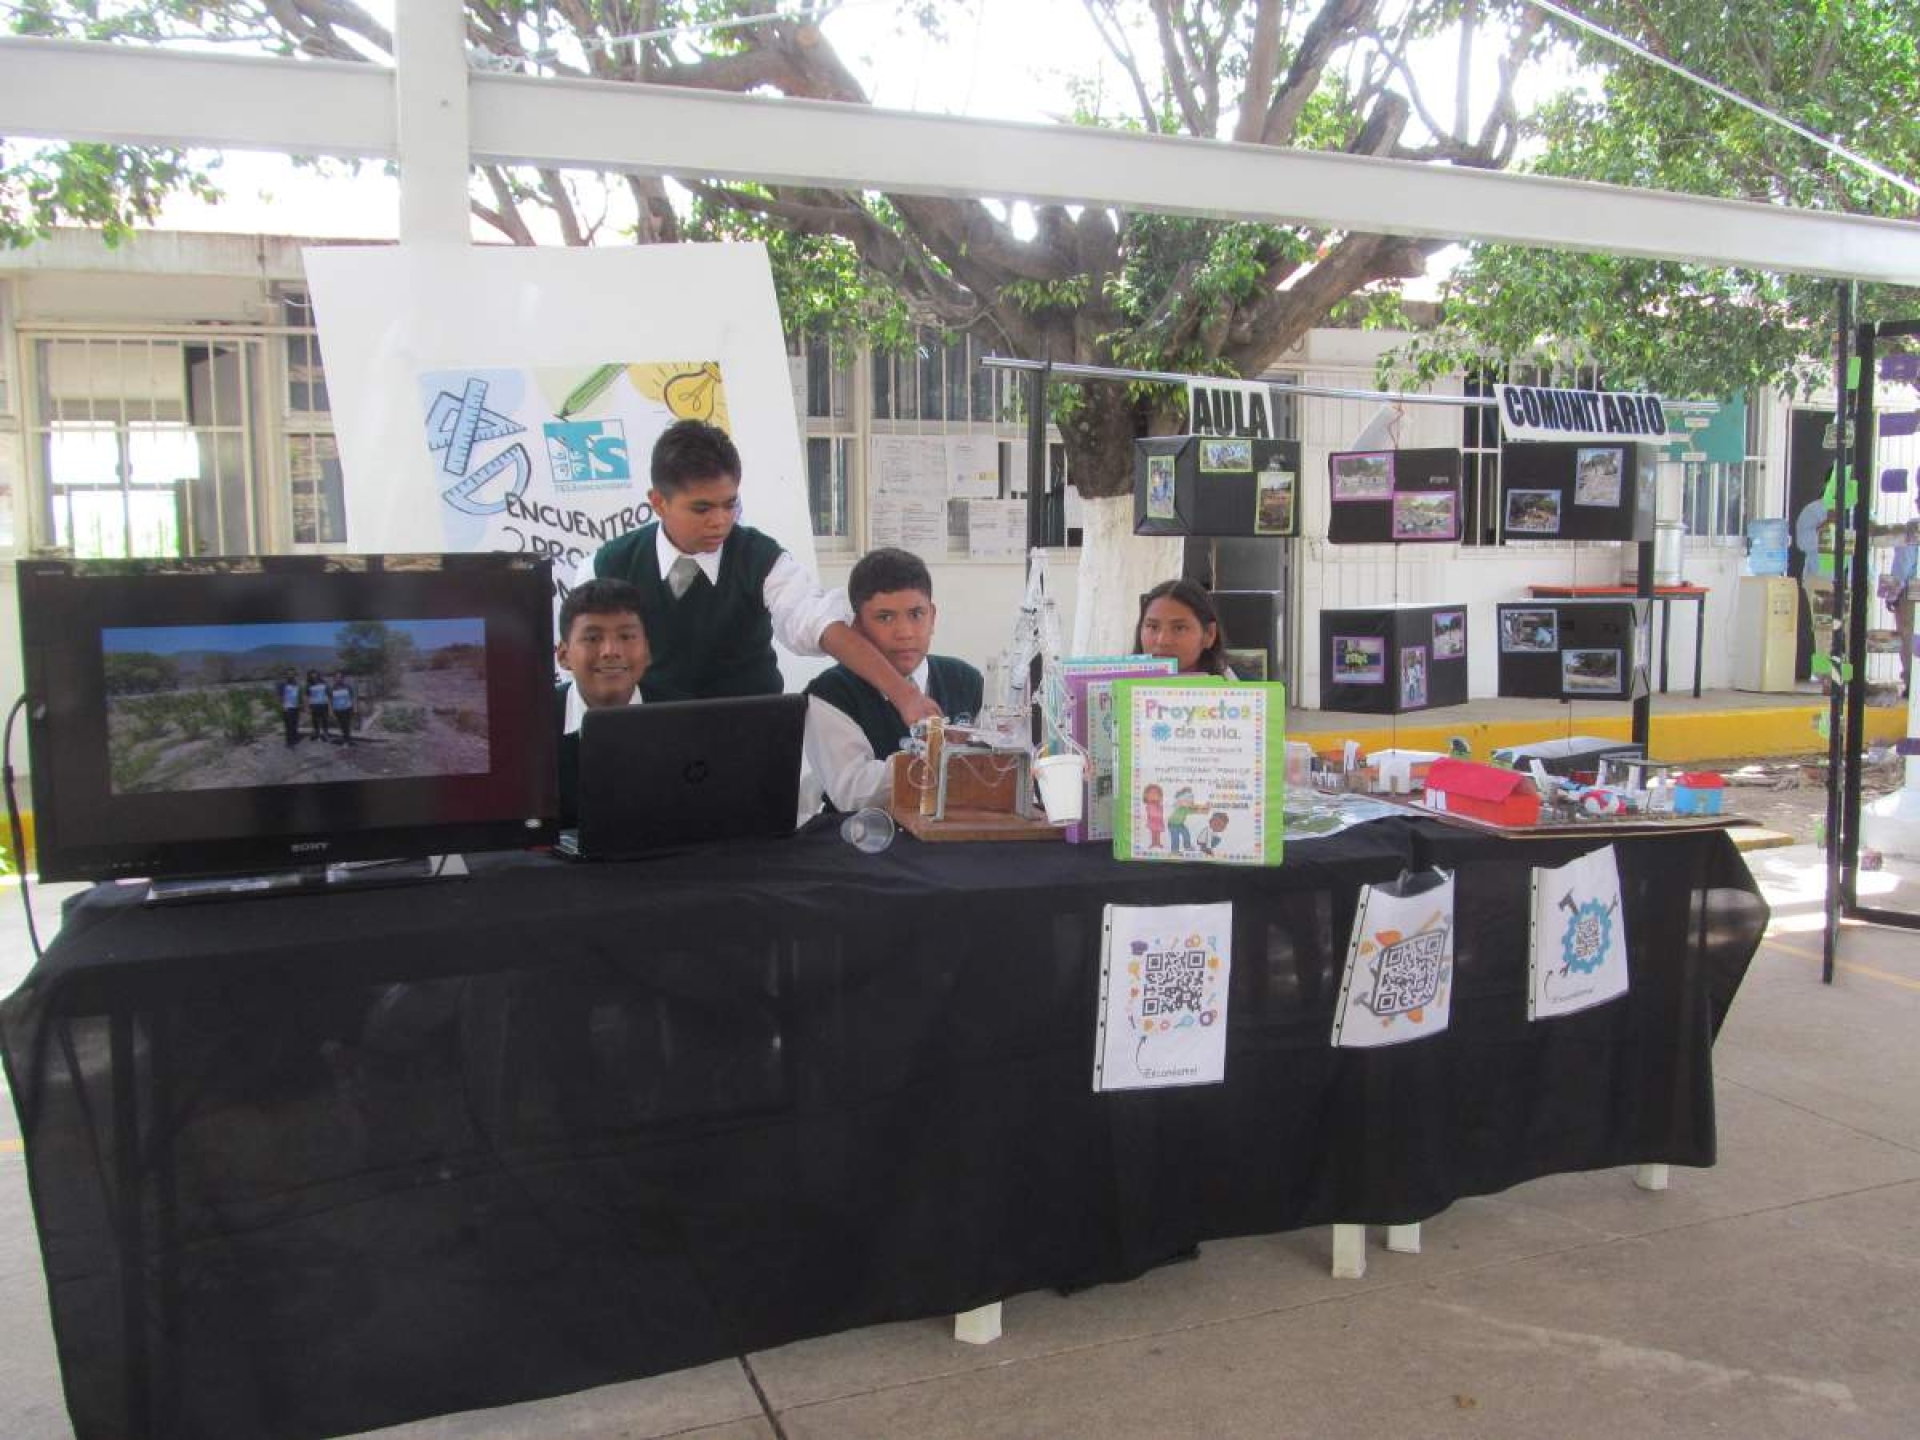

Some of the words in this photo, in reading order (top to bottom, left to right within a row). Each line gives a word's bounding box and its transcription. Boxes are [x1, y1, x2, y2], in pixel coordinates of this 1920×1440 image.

[1191, 387, 1270, 437] AULA
[1503, 386, 1666, 436] COMUNITARIO
[505, 492, 651, 539] ENCUENTRO
[1145, 699, 1250, 725] Proyectos
[1175, 725, 1195, 739] de
[291, 842, 329, 852] SONY
